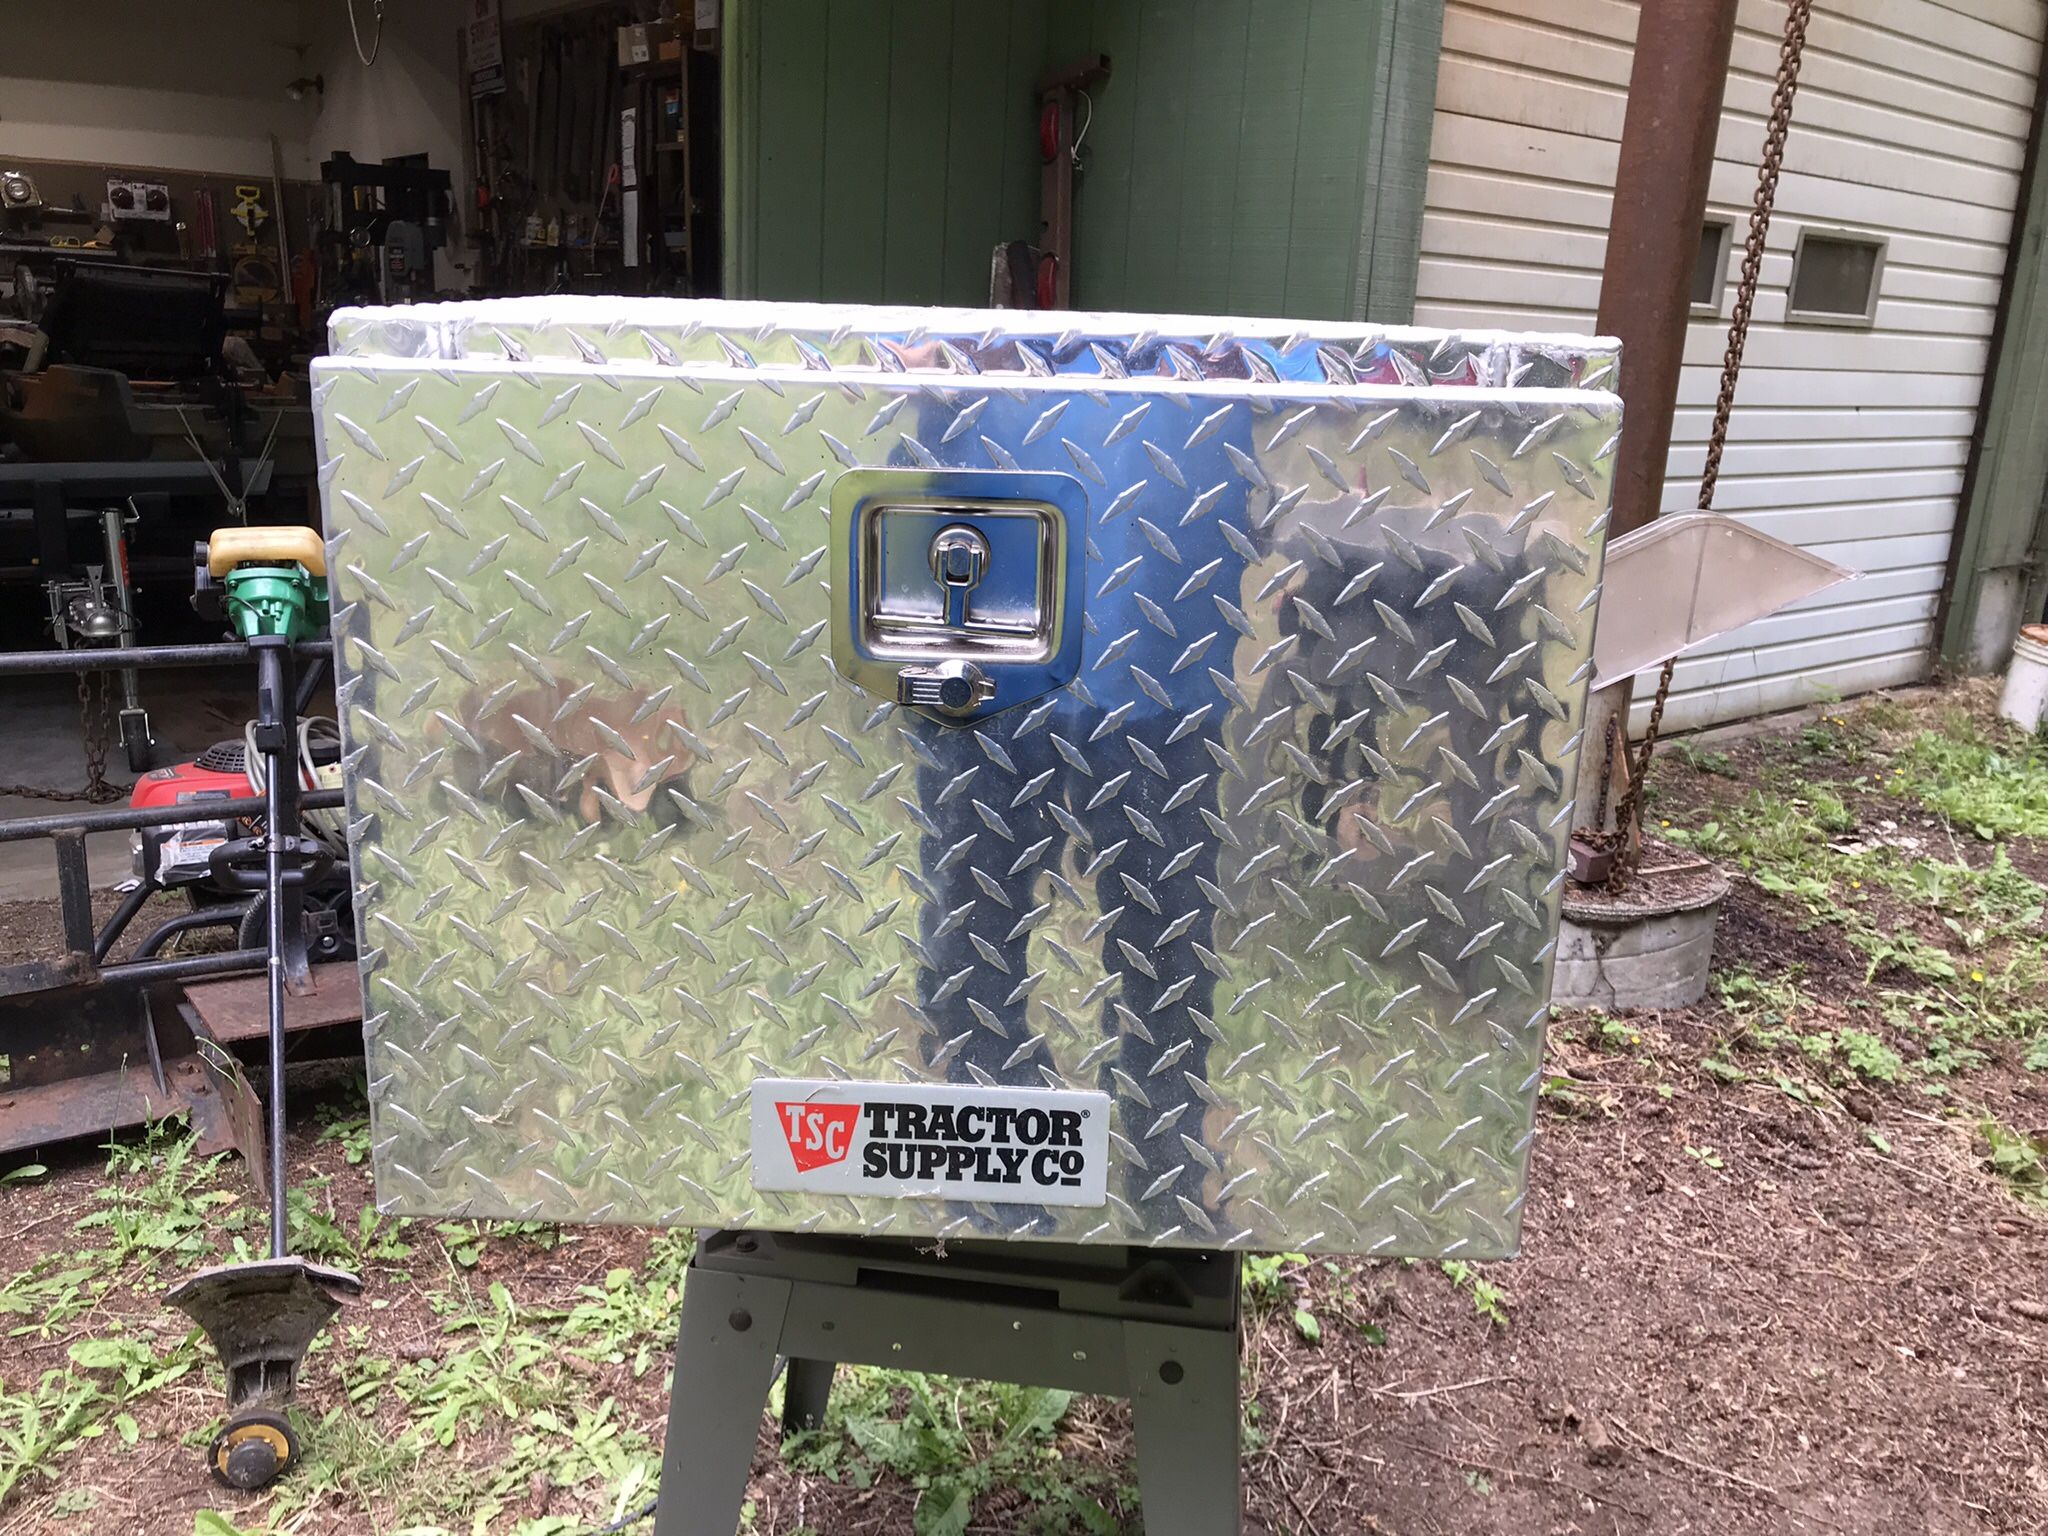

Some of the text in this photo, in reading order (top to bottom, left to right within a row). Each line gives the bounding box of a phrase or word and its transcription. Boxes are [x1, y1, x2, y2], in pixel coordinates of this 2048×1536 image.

[785, 1105, 845, 1159] TSC
[864, 1102, 1083, 1146] TRACTOR
[863, 1142, 1029, 1184] SUPPLY
